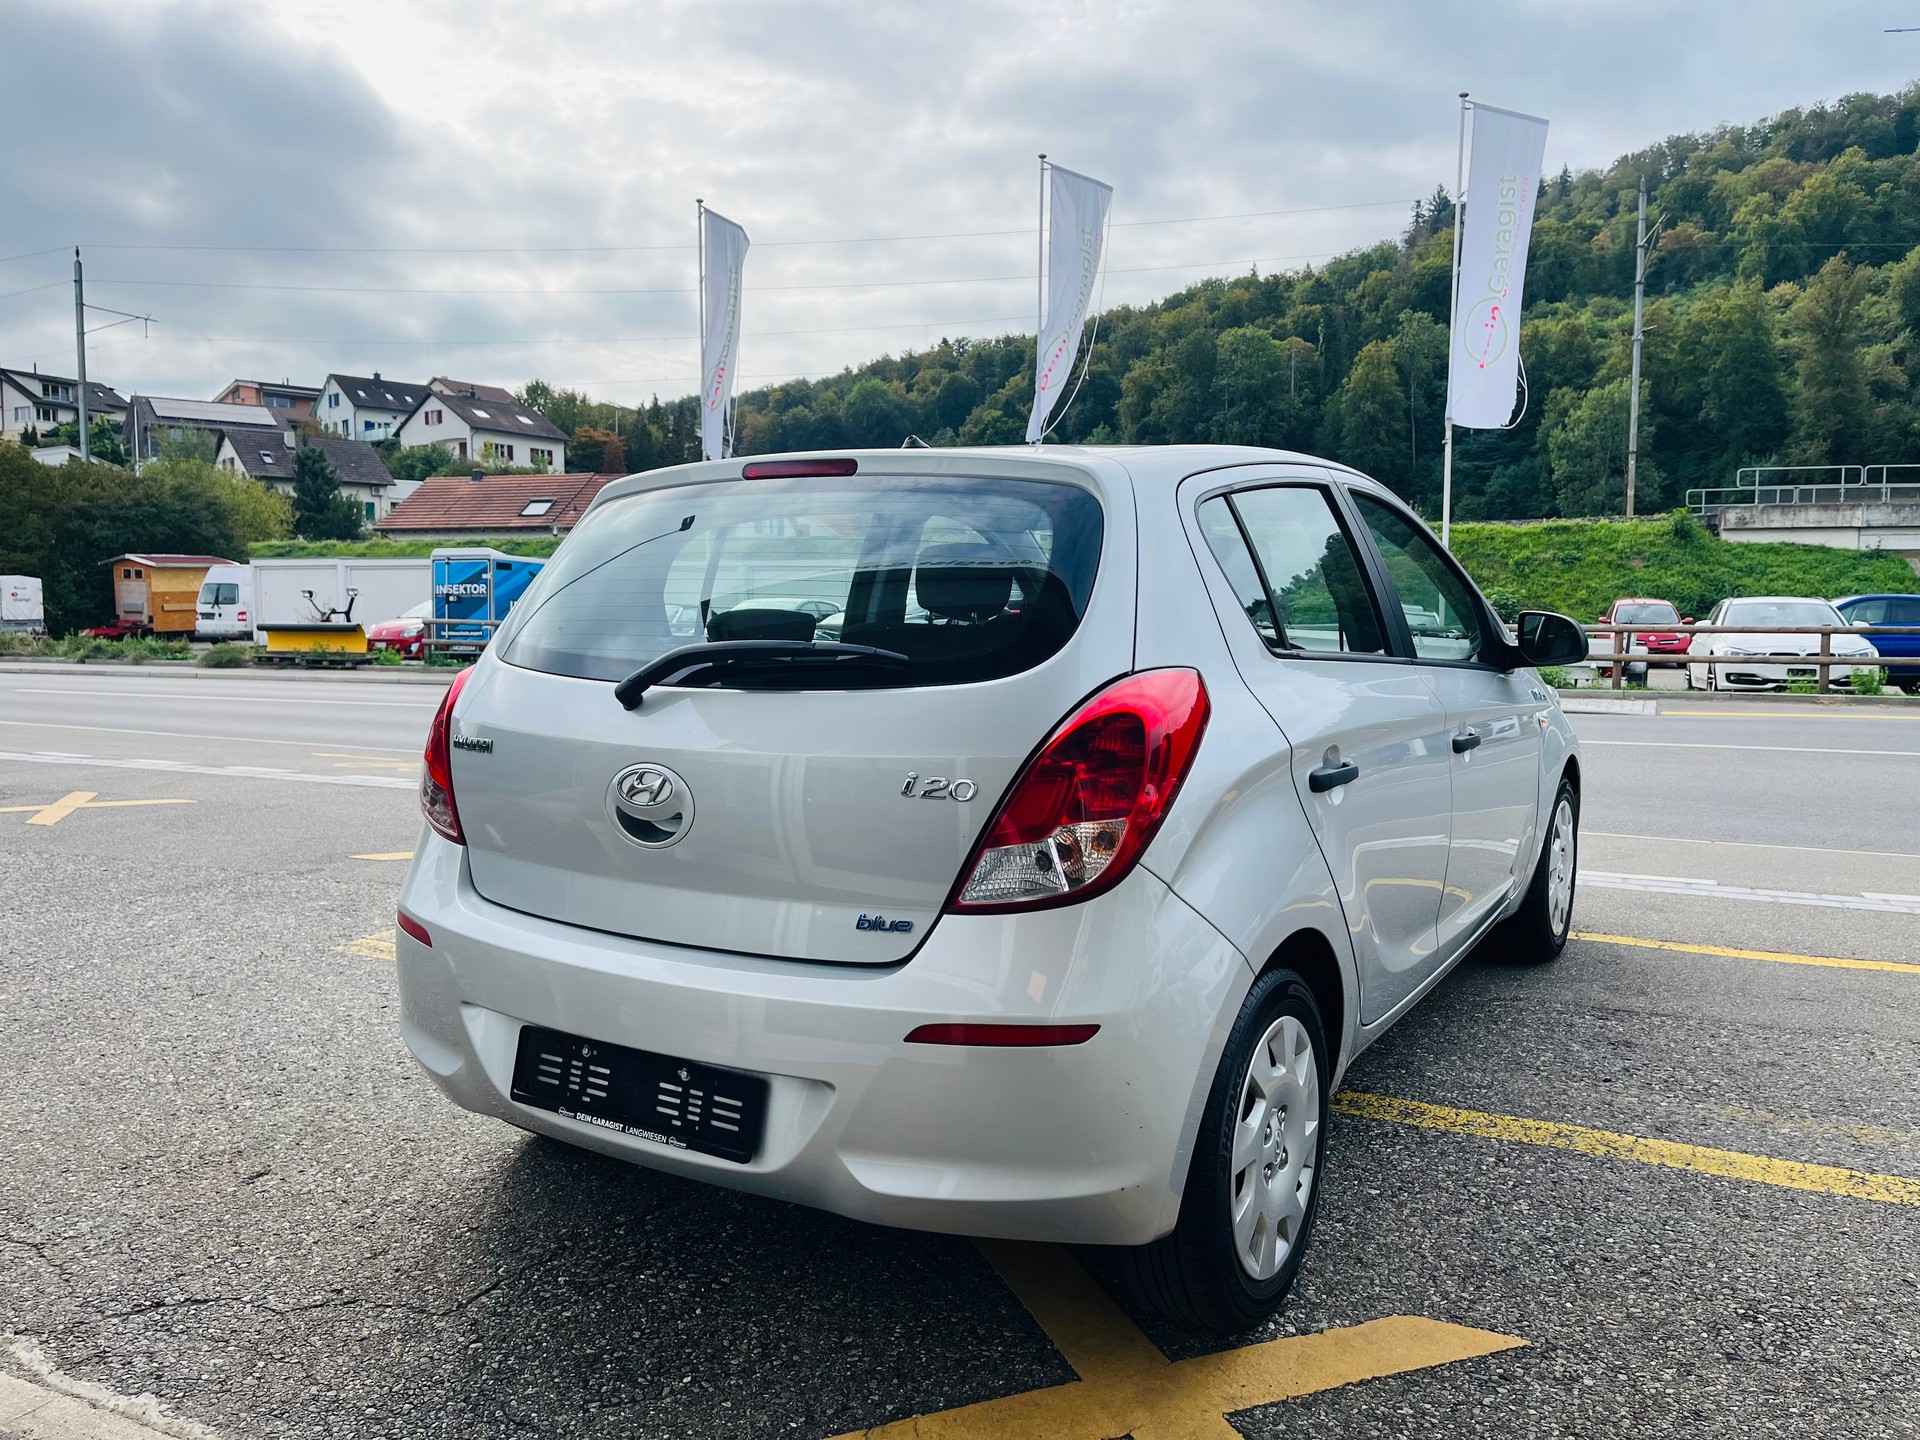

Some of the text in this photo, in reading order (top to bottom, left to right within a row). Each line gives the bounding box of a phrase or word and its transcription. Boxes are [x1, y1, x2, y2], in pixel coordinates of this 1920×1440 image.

[1488, 174, 1517, 295] Garagist
[436, 583, 487, 595] INSEKTOR
[901, 771, 979, 802] i20
[855, 913, 914, 934] blue
[576, 1112, 592, 1123] DEIN
[592, 1116, 624, 1132] GARAGIST
[625, 1125, 667, 1144] LANGWIESEN
